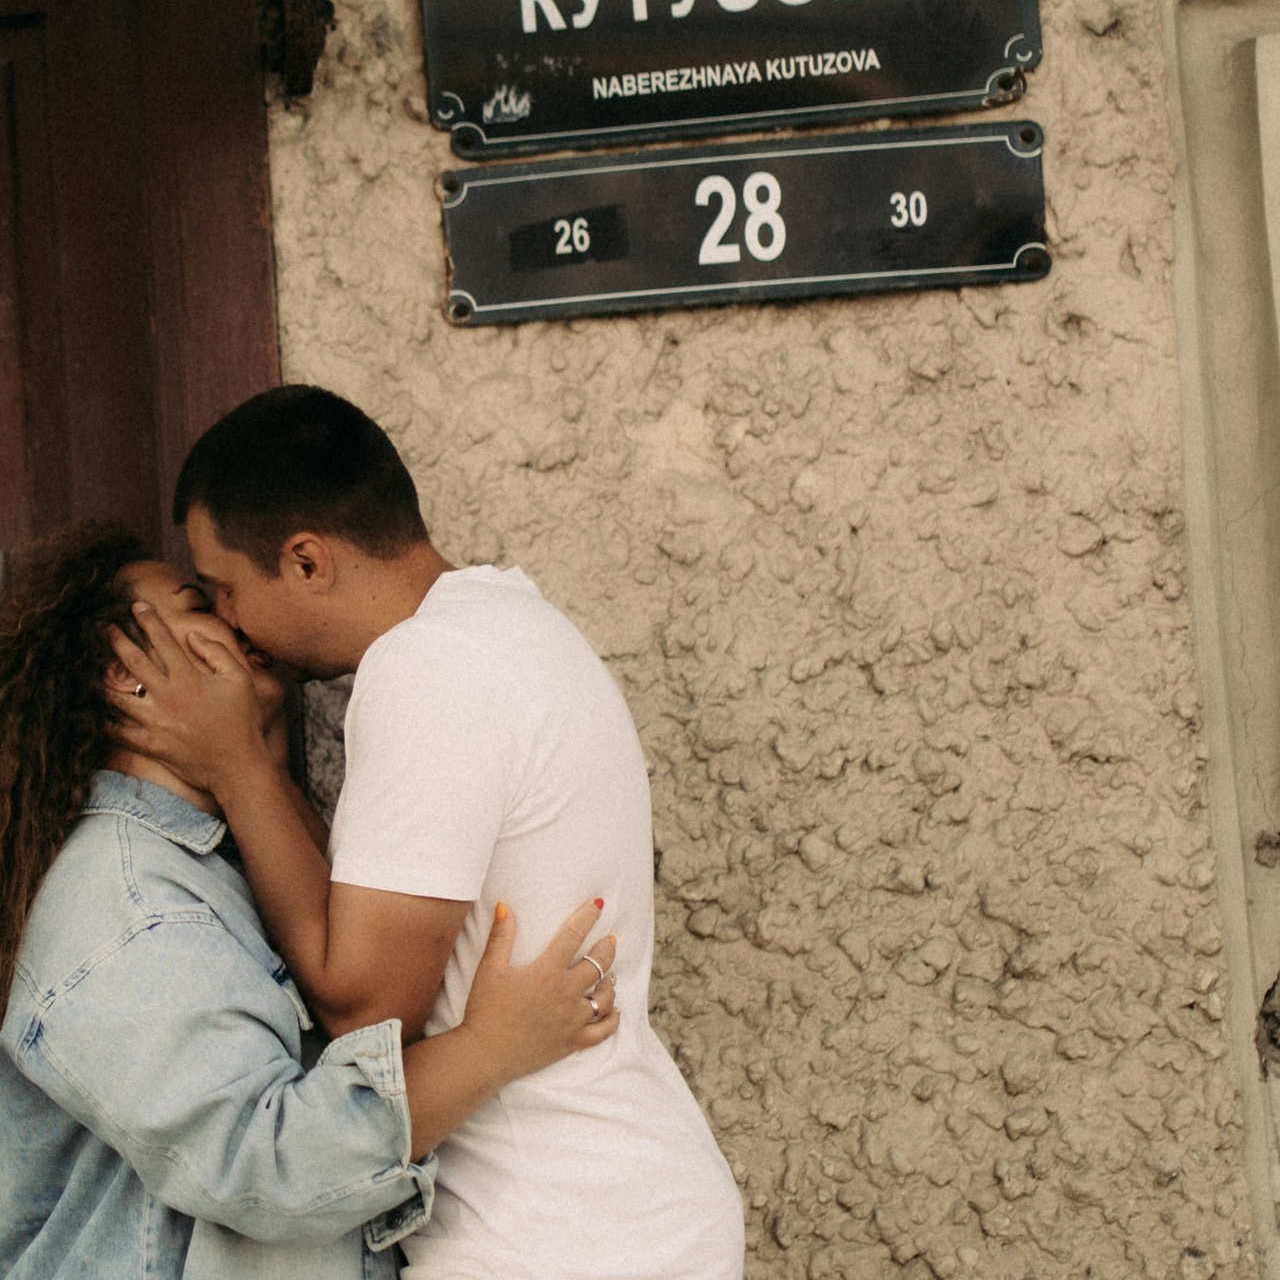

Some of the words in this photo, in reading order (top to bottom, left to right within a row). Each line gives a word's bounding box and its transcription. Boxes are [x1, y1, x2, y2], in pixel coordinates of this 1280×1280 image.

[592, 60, 763, 99] NABEREZHNAYA
[765, 48, 881, 81] KUTUZOVA
[554, 217, 590, 255] 26
[694, 171, 787, 266] 28
[889, 190, 928, 228] 30
